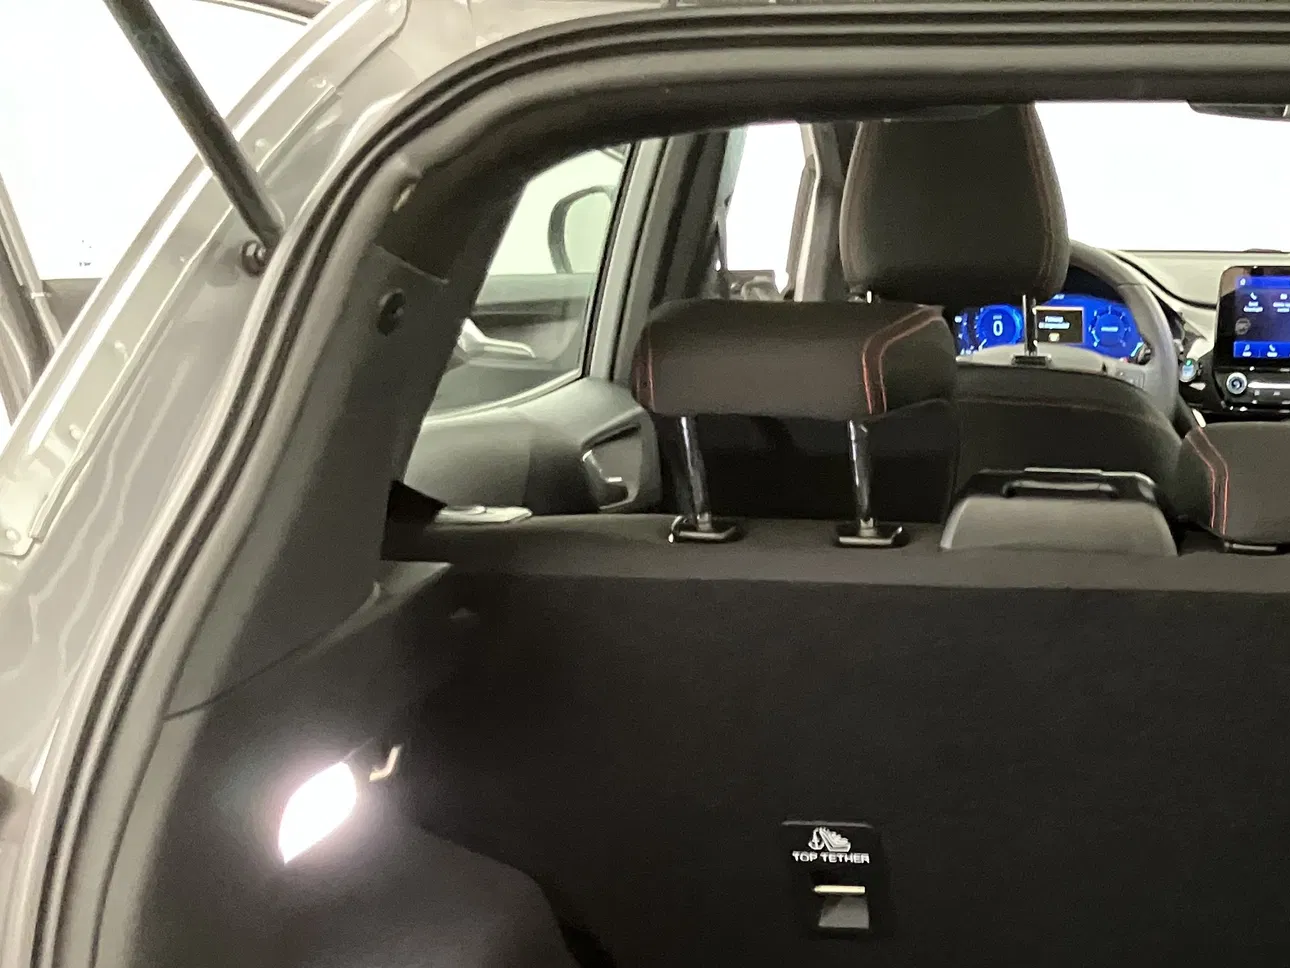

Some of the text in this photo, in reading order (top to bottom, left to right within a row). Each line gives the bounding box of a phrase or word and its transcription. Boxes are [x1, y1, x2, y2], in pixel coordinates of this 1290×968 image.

[993, 320, 1003, 337] 0
[792, 850, 870, 864] TOP TETHER
